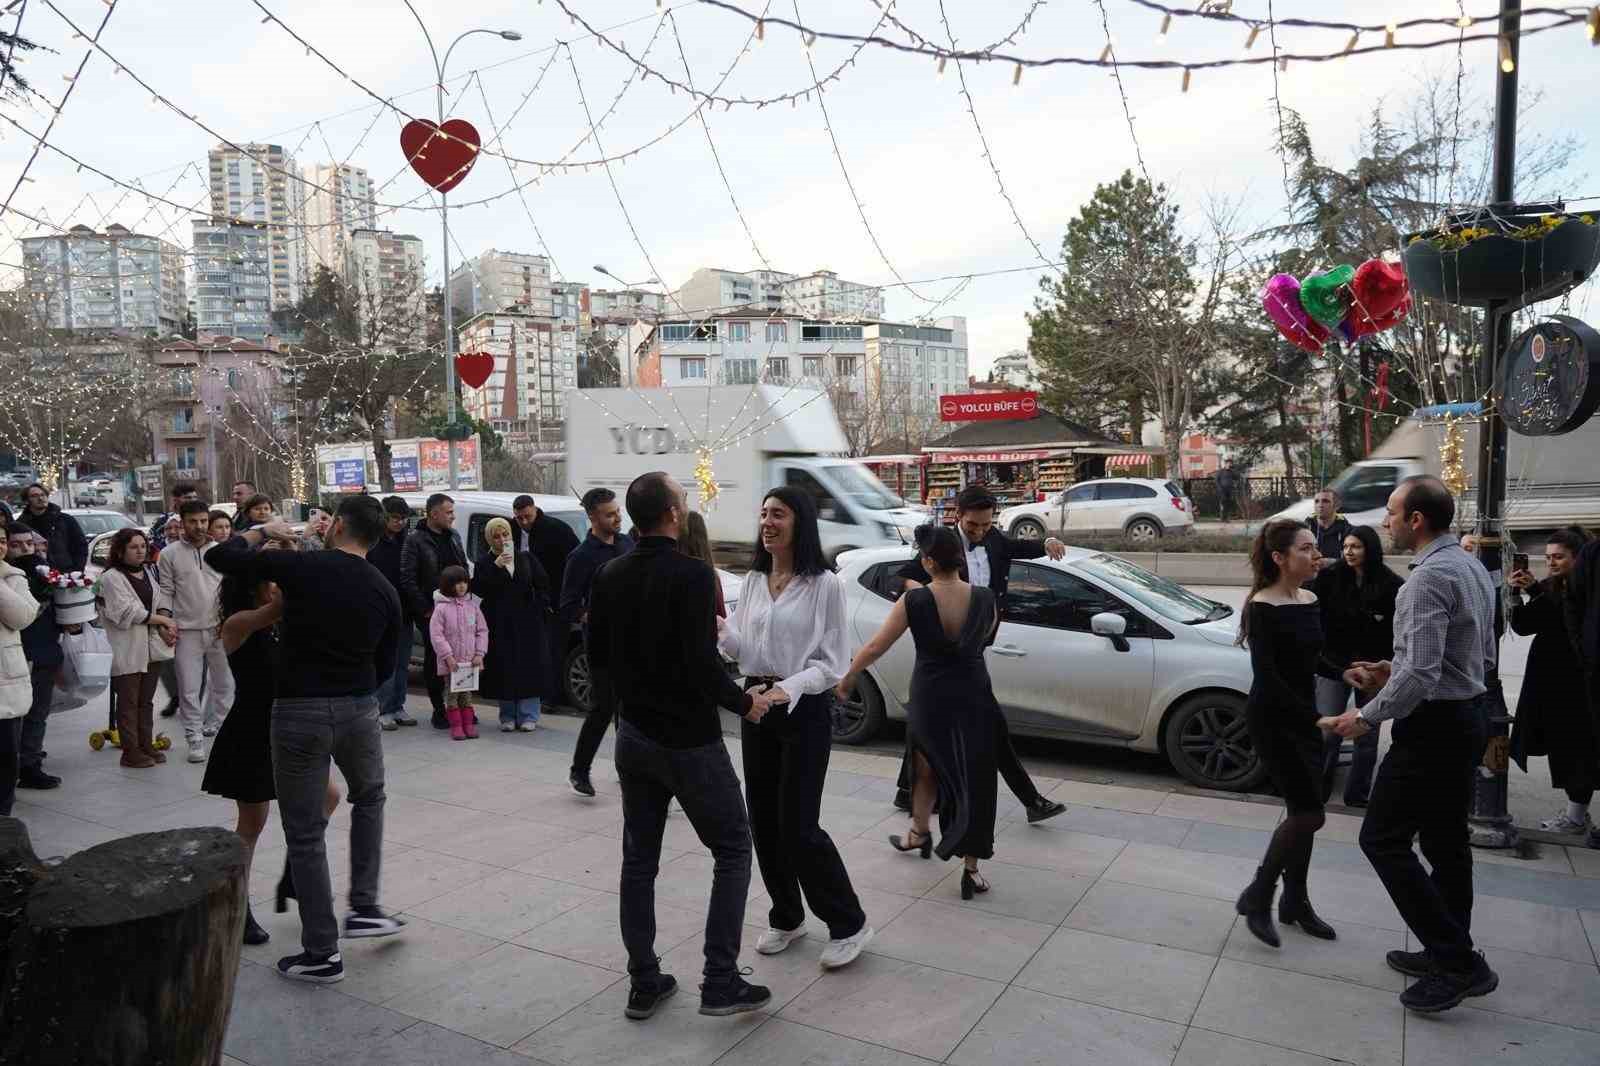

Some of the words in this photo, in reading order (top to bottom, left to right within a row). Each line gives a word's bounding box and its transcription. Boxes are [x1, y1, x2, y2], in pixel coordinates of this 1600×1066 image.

[960, 403, 992, 413] YOLCU
[993, 400, 1019, 412] BÜFE
[951, 453, 996, 462] YOLCU
